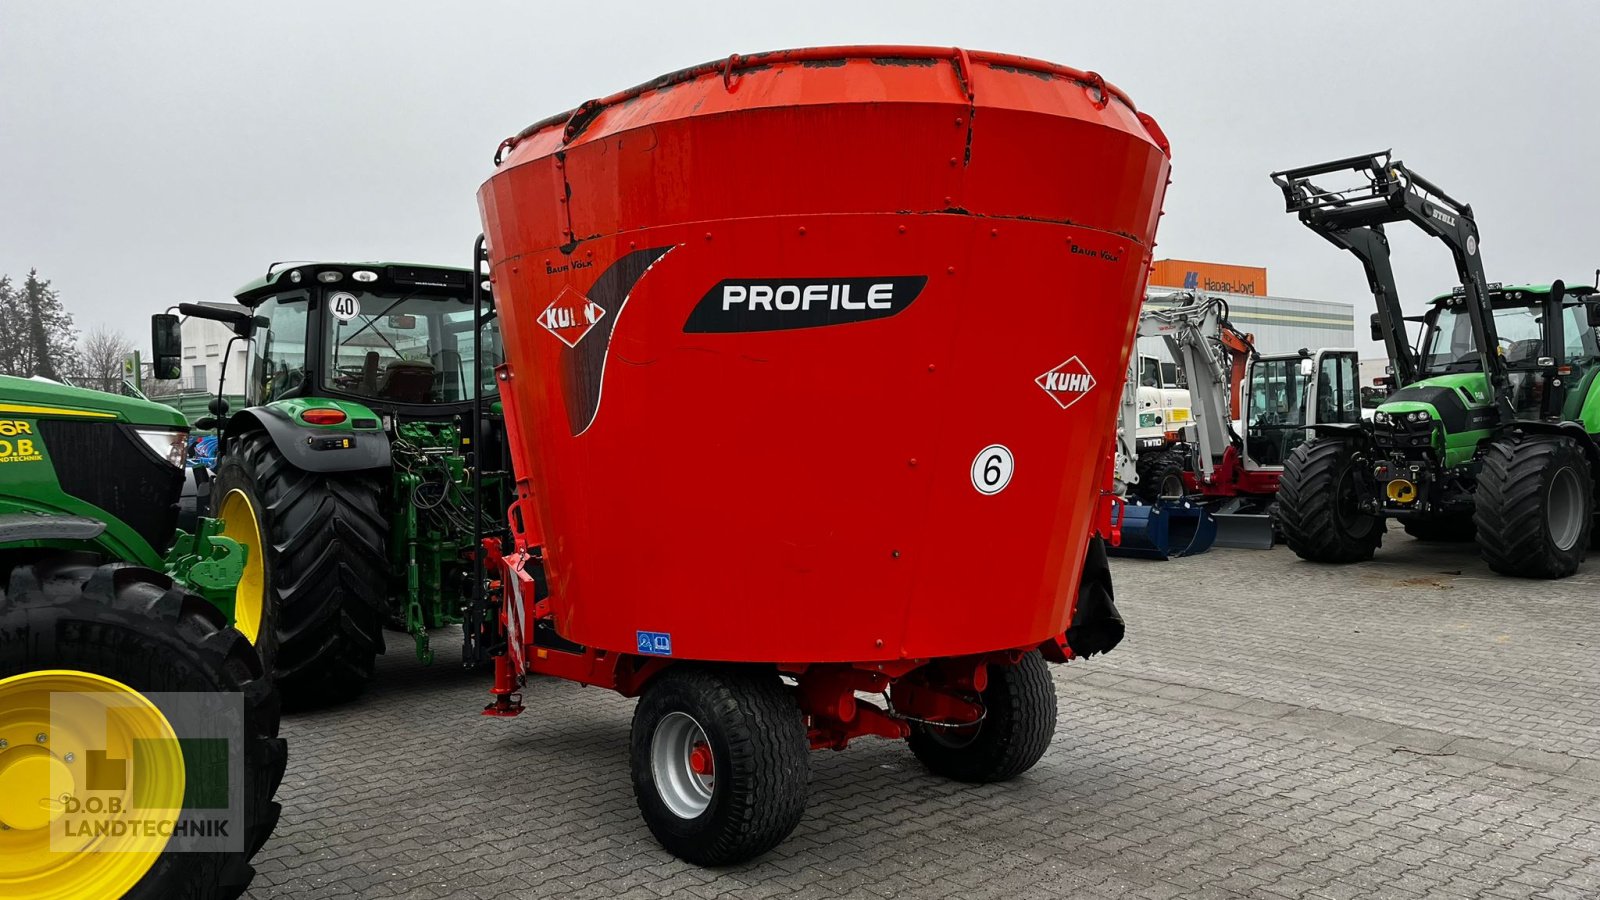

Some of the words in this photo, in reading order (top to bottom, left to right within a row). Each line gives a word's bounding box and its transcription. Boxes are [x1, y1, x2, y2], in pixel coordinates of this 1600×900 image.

[1433, 209, 1456, 227] STOLL
[1204, 277, 1255, 295] Hapag-Lloyd
[336, 297, 354, 315] 40
[722, 284, 893, 310] PROFILE
[1045, 371, 1092, 392] KUHN
[984, 454, 1003, 486] 6
